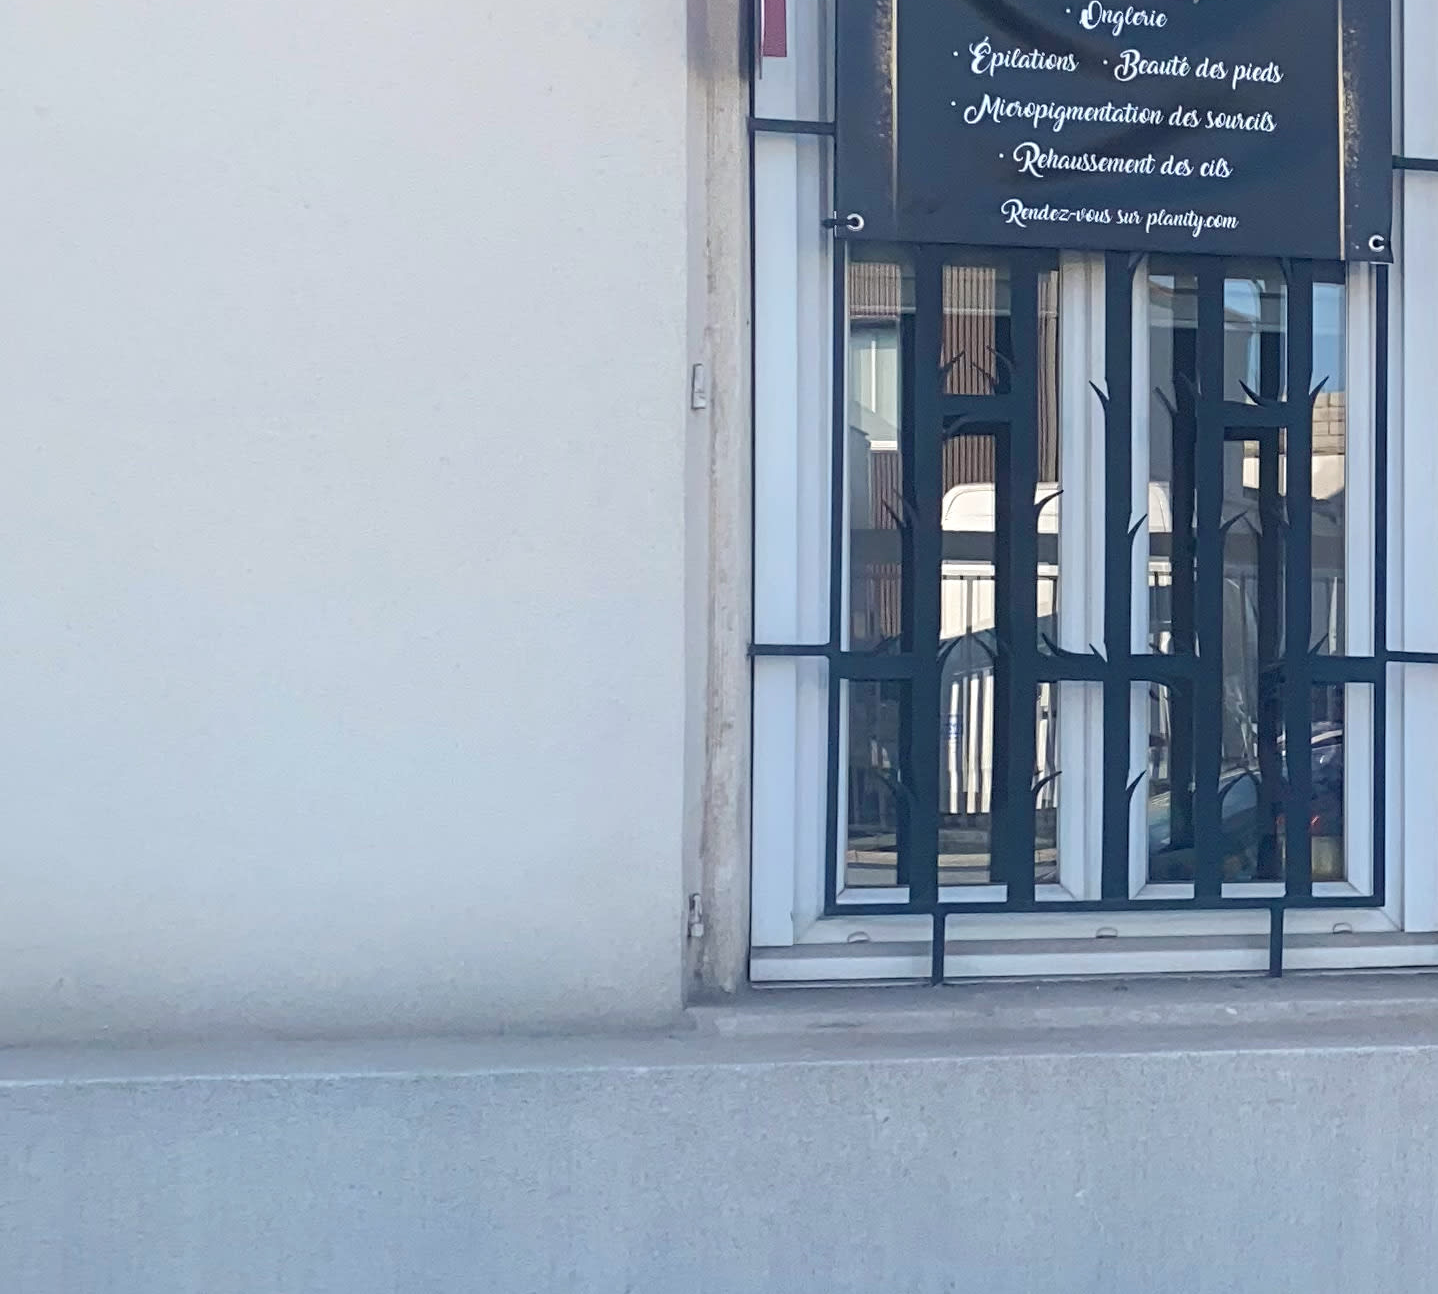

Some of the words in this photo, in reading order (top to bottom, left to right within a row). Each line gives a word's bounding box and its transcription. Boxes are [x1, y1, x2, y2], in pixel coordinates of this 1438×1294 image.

[1079, 0, 1168, 36] Onglerie
[969, 36, 1079, 76] Épilations
[1114, 49, 1191, 82] Beauté
[1195, 58, 1229, 80] des
[1232, 63, 1284, 90] pieds
[963, 94, 1165, 133] Micropigmentation
[1168, 105, 1202, 129] des
[1204, 110, 1278, 132] sourcils
[1012, 142, 1155, 178] Rehaussement
[1160, 155, 1194, 177] des
[1199, 158, 1234, 178] cils
[1000, 198, 1113, 228] Rendez-vous
[1115, 208, 1143, 226] sur
[1145, 207, 1240, 238] planity.com
